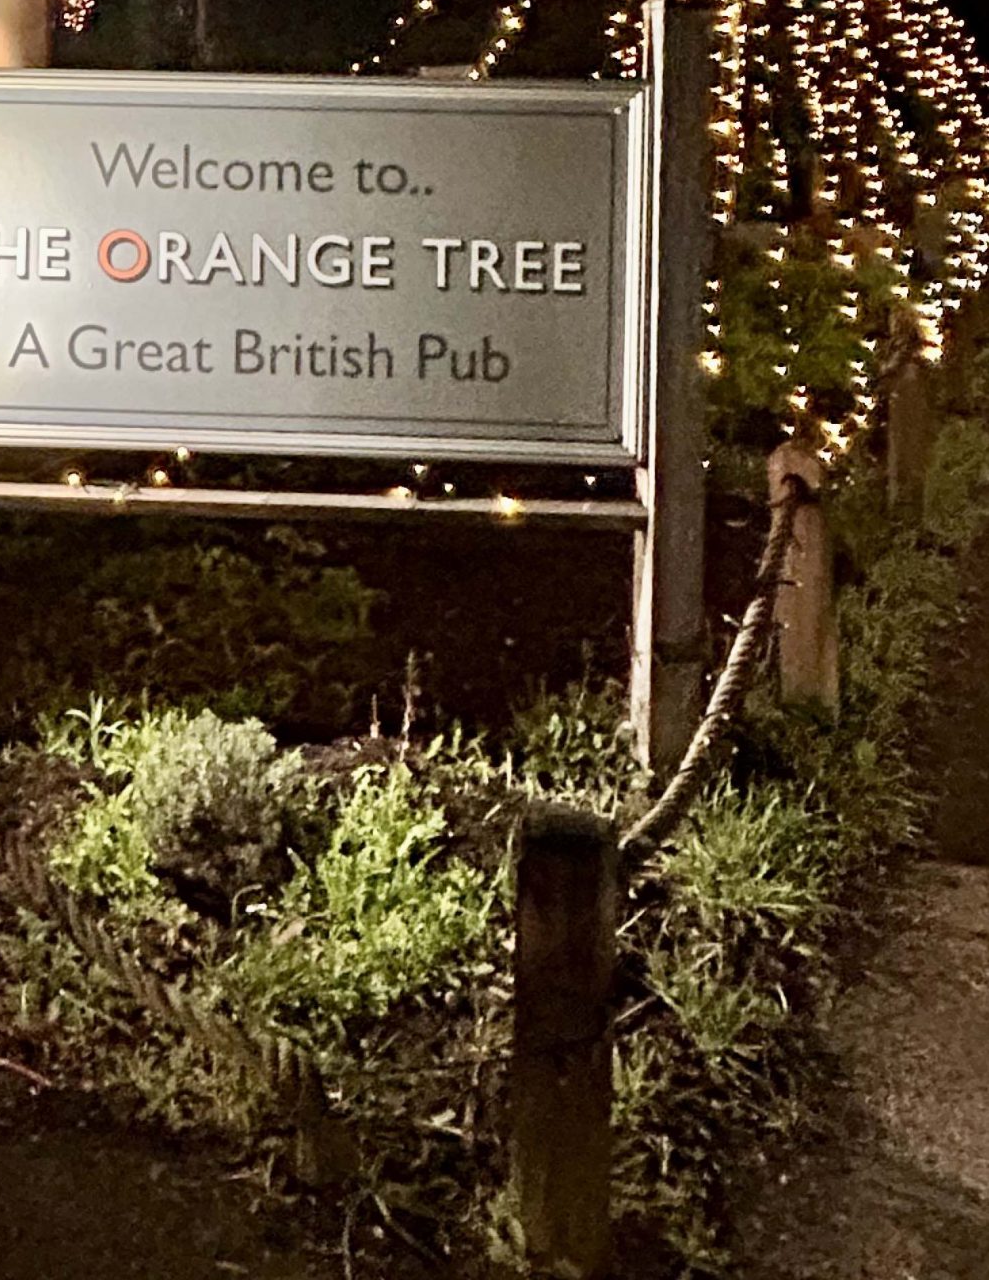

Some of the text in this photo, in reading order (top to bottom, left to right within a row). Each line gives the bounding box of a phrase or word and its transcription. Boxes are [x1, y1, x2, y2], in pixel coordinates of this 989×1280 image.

[91, 142, 433, 195] Welcome to..
[97, 228, 395, 290] ORANGE
[421, 238, 587, 295] TREE
[8, 322, 511, 383] A Great British Pub
